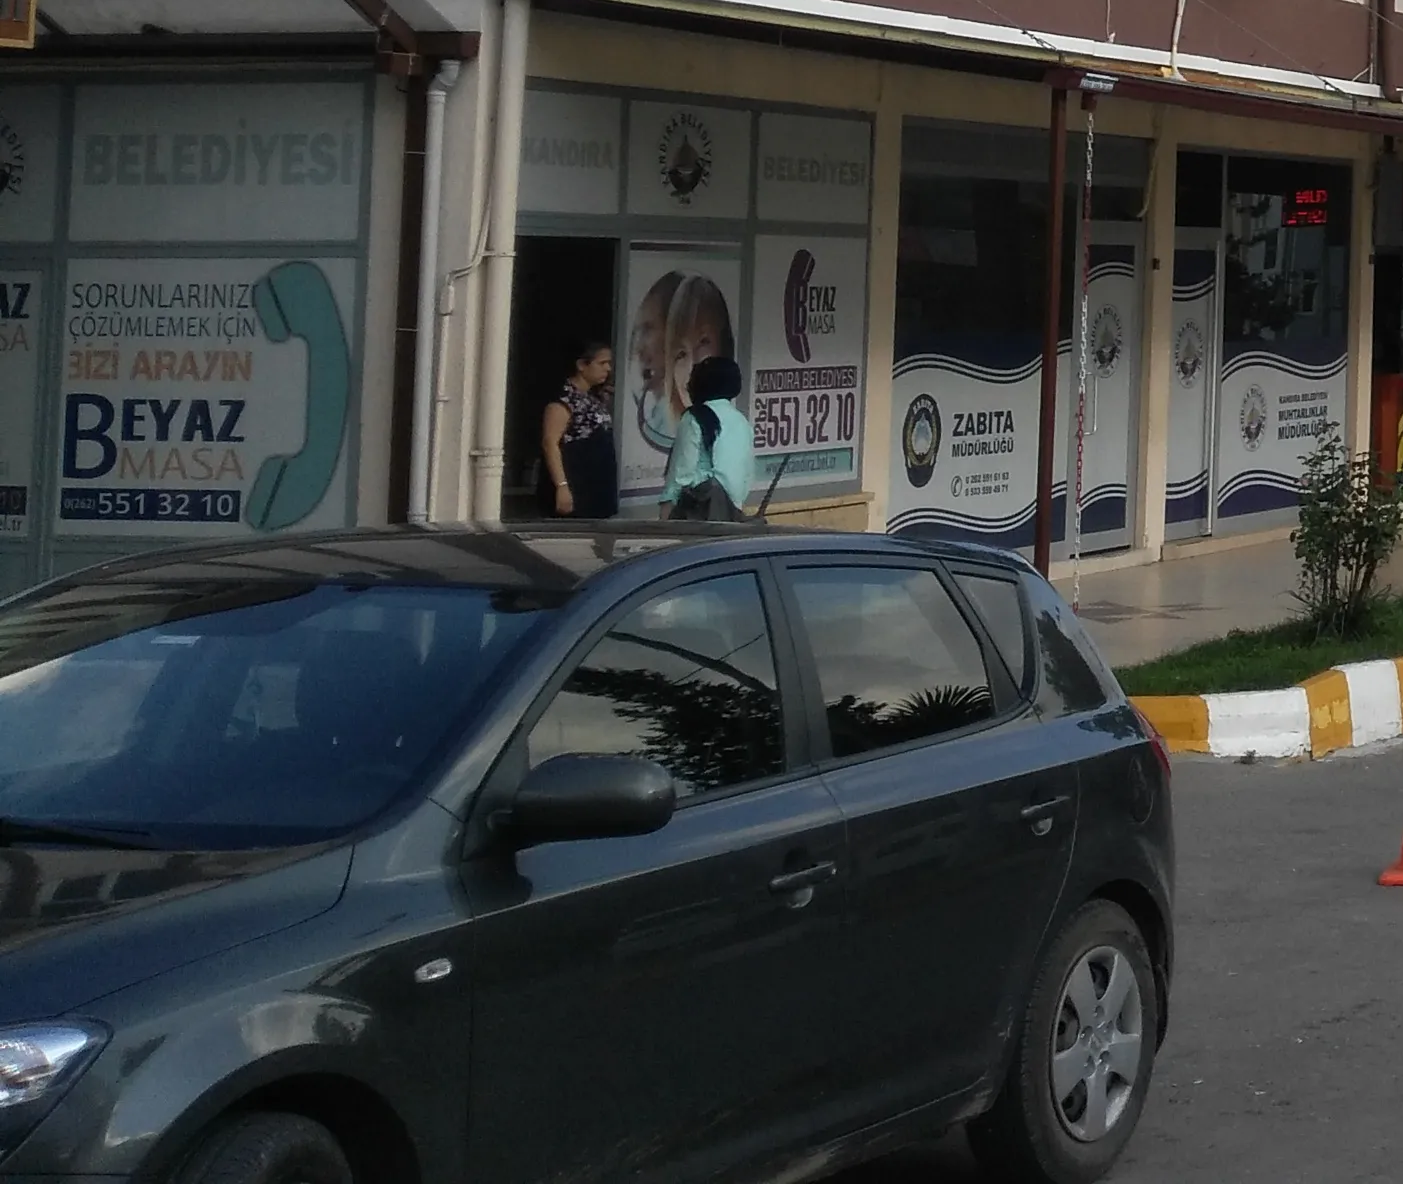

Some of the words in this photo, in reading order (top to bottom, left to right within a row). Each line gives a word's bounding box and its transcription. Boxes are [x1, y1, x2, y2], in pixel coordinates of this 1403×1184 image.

[83, 120, 354, 187] BELEDİYESİ
[523, 137, 613, 170] KANDIRA
[72, 283, 257, 309] SORUNLARINIZI
[69, 312, 212, 344] ÇÖZÜMLEMEK
[216, 312, 256, 345] İÇİN
[808, 316, 836, 335] MASA
[131, 350, 253, 382] ARAYIN
[755, 372, 800, 392] KANDIRA
[62, 393, 246, 479] BEYAZ
[753, 398, 768, 449] 0262
[766, 396, 800, 448] 551
[805, 393, 831, 444] 32
[836, 392, 855, 442] 10
[952, 410, 1015, 437] ZABITA
[951, 437, 1014, 458] MÜDÜRLÜĞÜ
[118, 447, 245, 481] MASA
[98, 493, 146, 514] 551
[157, 494, 190, 516] 32
[200, 493, 234, 516] 10
